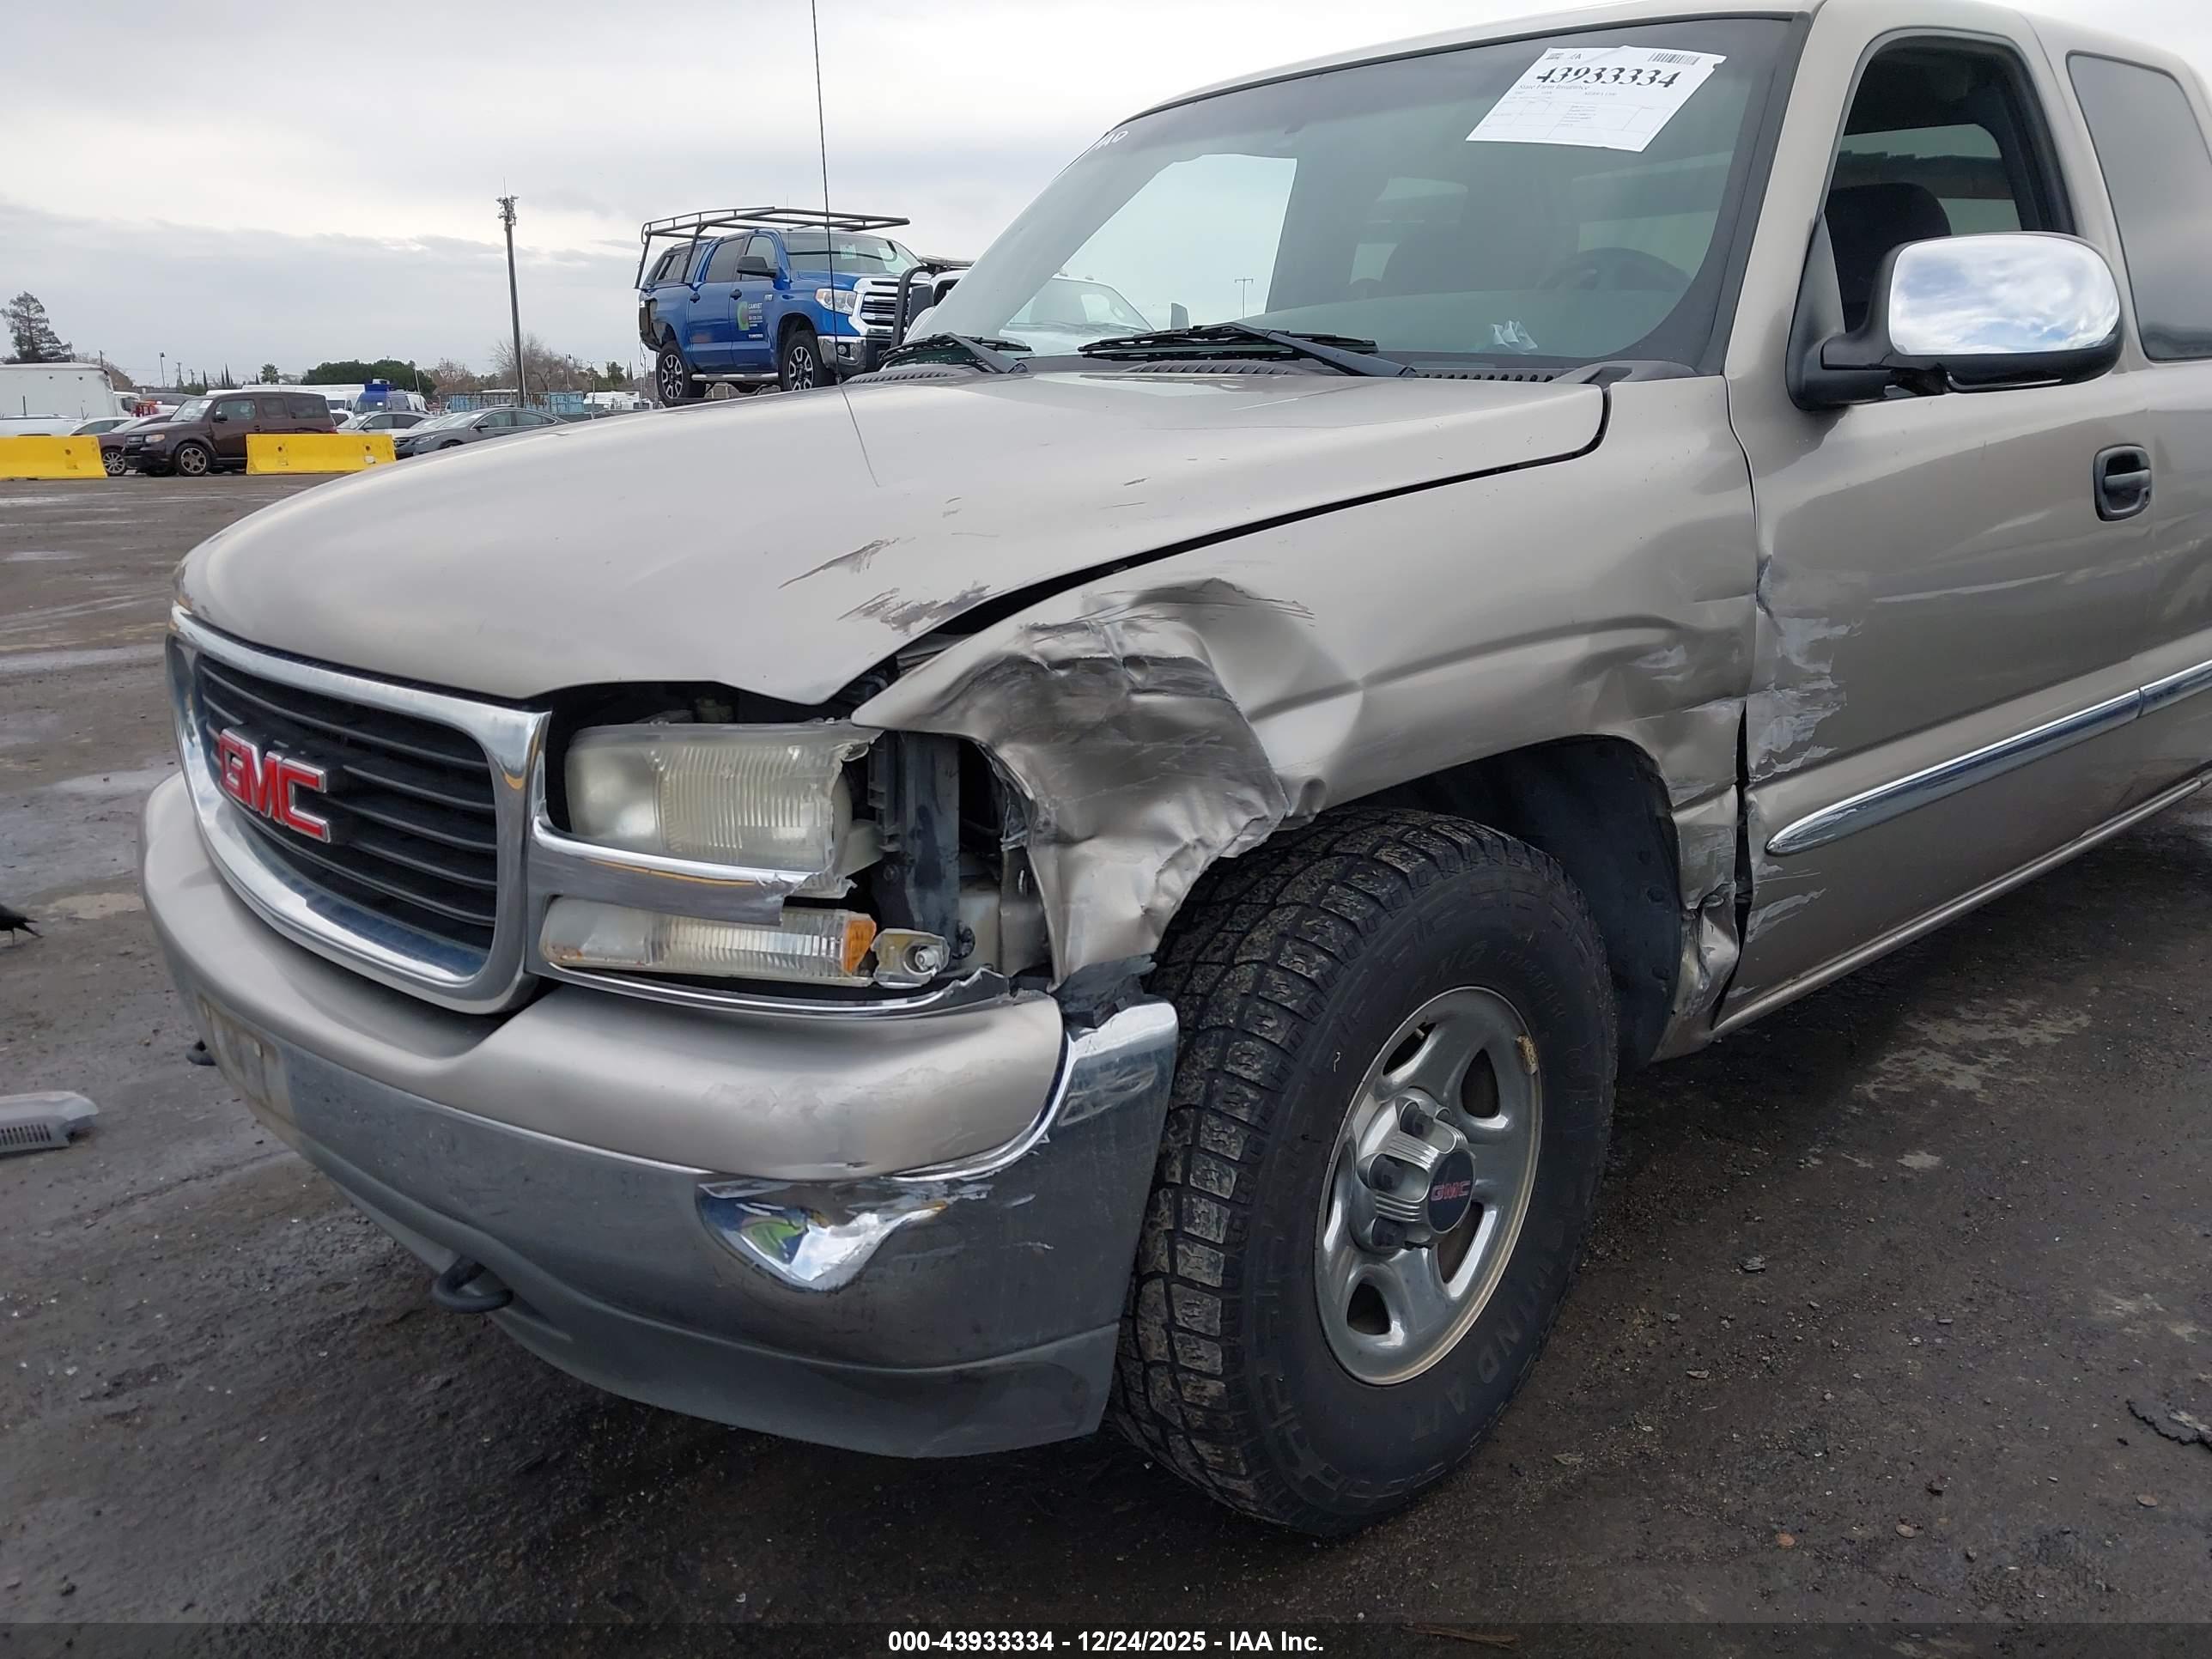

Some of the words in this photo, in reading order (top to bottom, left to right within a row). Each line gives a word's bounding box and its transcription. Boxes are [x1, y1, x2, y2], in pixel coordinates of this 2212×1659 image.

[1536, 66, 1681, 88] 43933334
[220, 729, 331, 843] GMC
[1431, 1180, 1471, 1201] GMC
